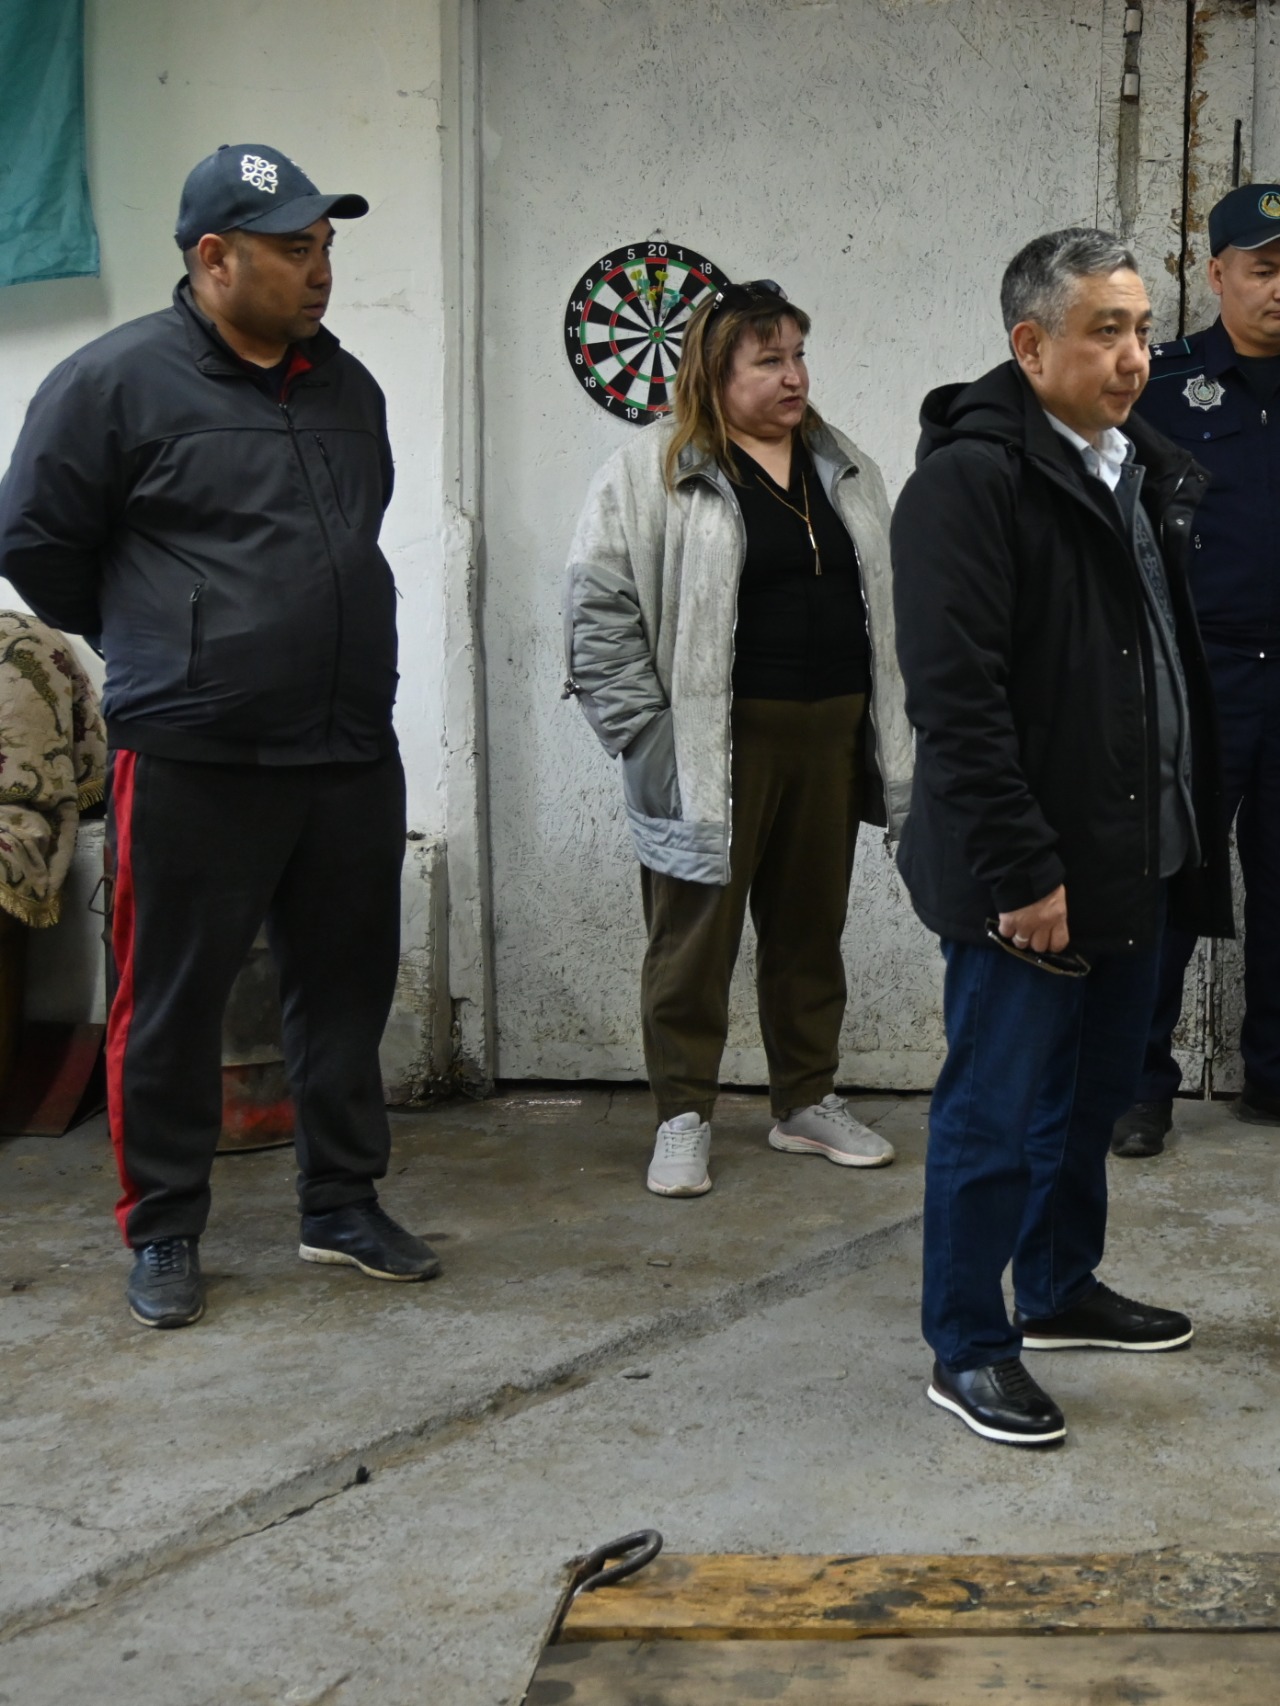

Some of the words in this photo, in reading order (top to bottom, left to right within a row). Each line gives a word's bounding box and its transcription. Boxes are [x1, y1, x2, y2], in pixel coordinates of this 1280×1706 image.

[627, 249, 635, 260] 5
[648, 244, 667, 257] 20
[678, 250, 684, 261] 1
[599, 260, 613, 271] 12
[699, 263, 712, 274] 18
[586, 279, 593, 290] 9
[571, 301, 584, 312] 14
[567, 327, 580, 337] 11
[575, 354, 583, 365] 8
[584, 376, 597, 388] 16
[605, 396, 614, 407] 7
[625, 408, 638, 419] 19
